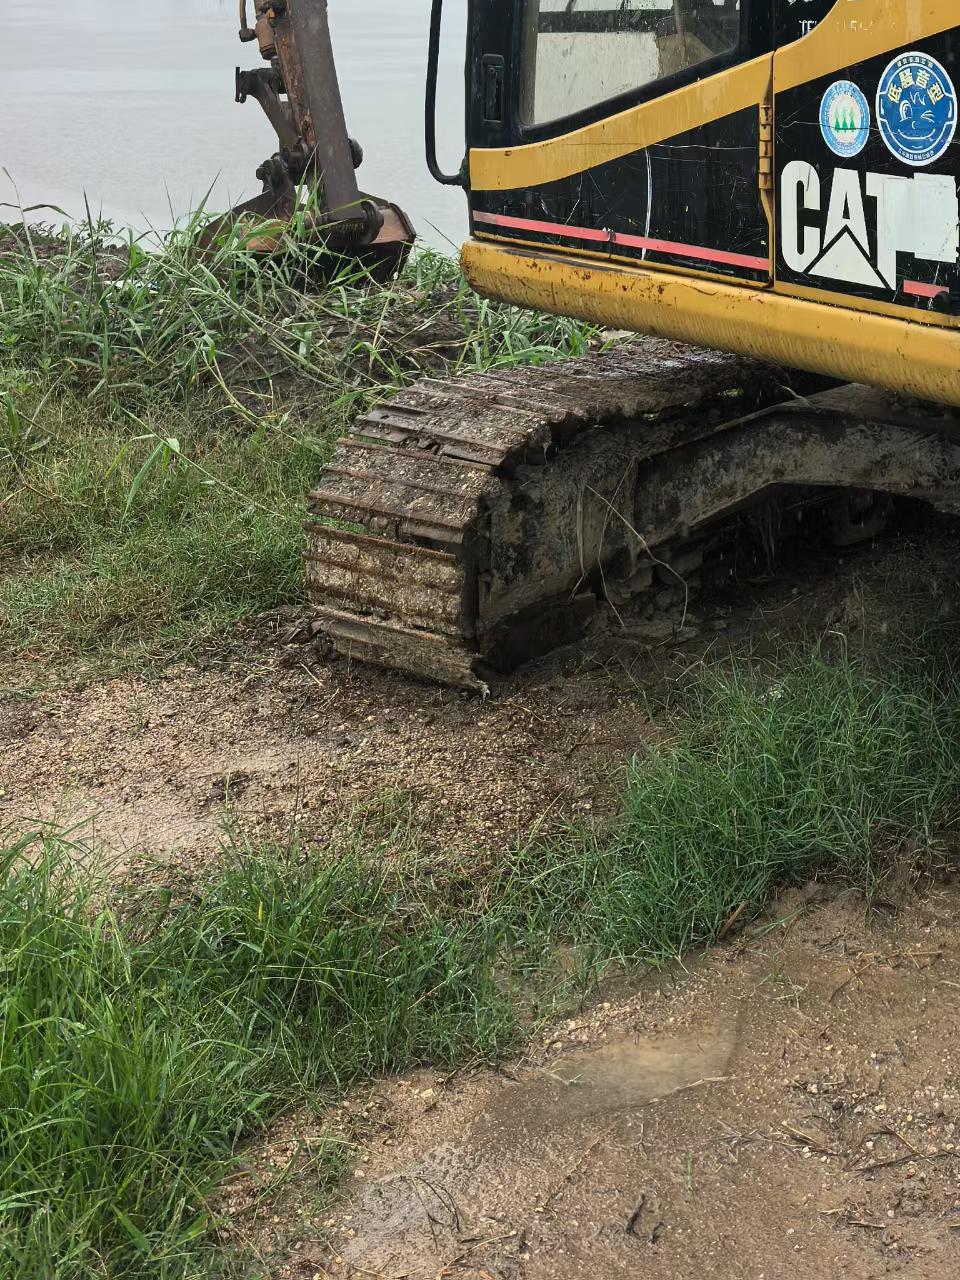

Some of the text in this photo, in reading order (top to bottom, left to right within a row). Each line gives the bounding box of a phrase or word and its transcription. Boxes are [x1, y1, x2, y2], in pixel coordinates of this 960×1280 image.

[888, 68, 945, 105] 低騒音型
[781, 160, 908, 291] CAT
